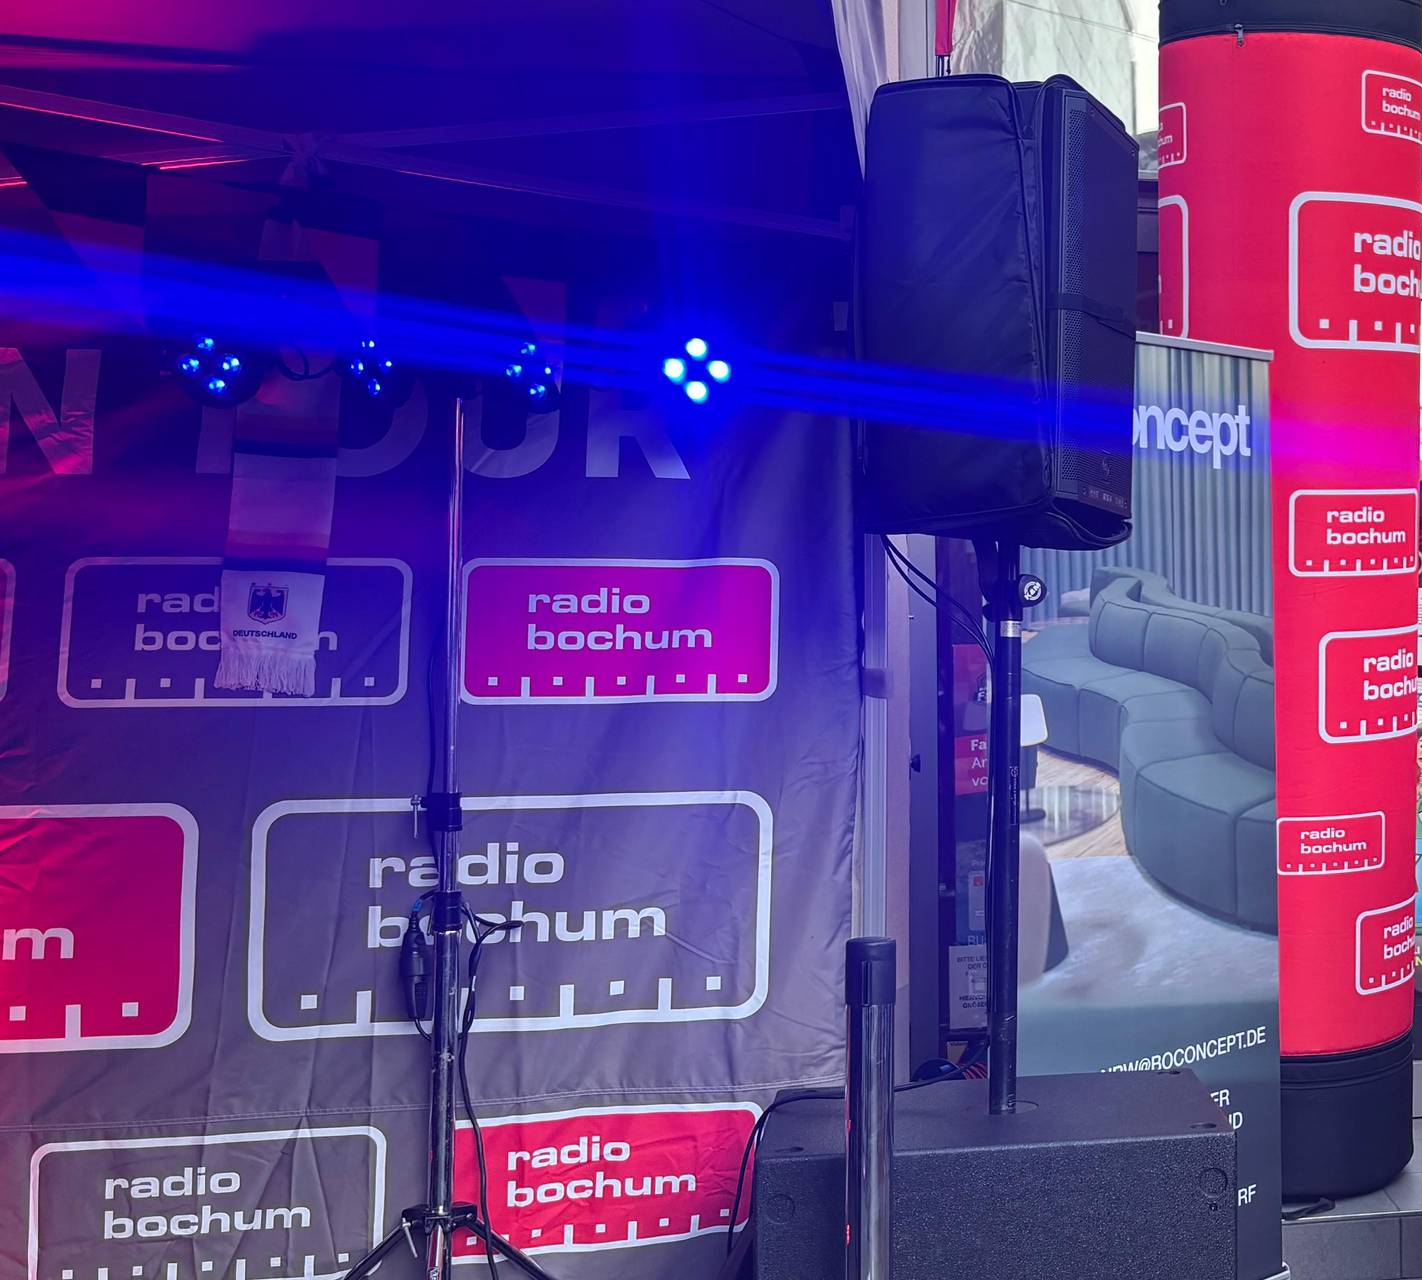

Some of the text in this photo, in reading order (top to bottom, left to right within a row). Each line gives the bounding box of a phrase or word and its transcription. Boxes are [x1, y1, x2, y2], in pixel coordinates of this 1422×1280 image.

[1382, 87, 1412, 102] radio
[1353, 229, 1421, 261] radio
[1353, 263, 1422, 299] boch
[1132, 404, 1252, 470] ncept
[1326, 506, 1386, 524] radio
[1326, 527, 1407, 545] bochum
[136, 586, 220, 614] rad
[527, 587, 651, 615] radio
[232, 629, 298, 640] DEUTSCHLAND
[526, 623, 713, 651] bochum
[1363, 648, 1414, 673] radio
[1363, 675, 1418, 701] bochu
[1300, 827, 1346, 840] radio
[1300, 841, 1367, 855] bochum
[369, 841, 565, 889] radio
[366, 900, 667, 949] bchum
[1383, 915, 1414, 940] radio
[508, 1135, 631, 1172] radio
[104, 1166, 242, 1201] radio
[507, 1171, 697, 1208] bochum
[103, 1204, 311, 1240] bochum
